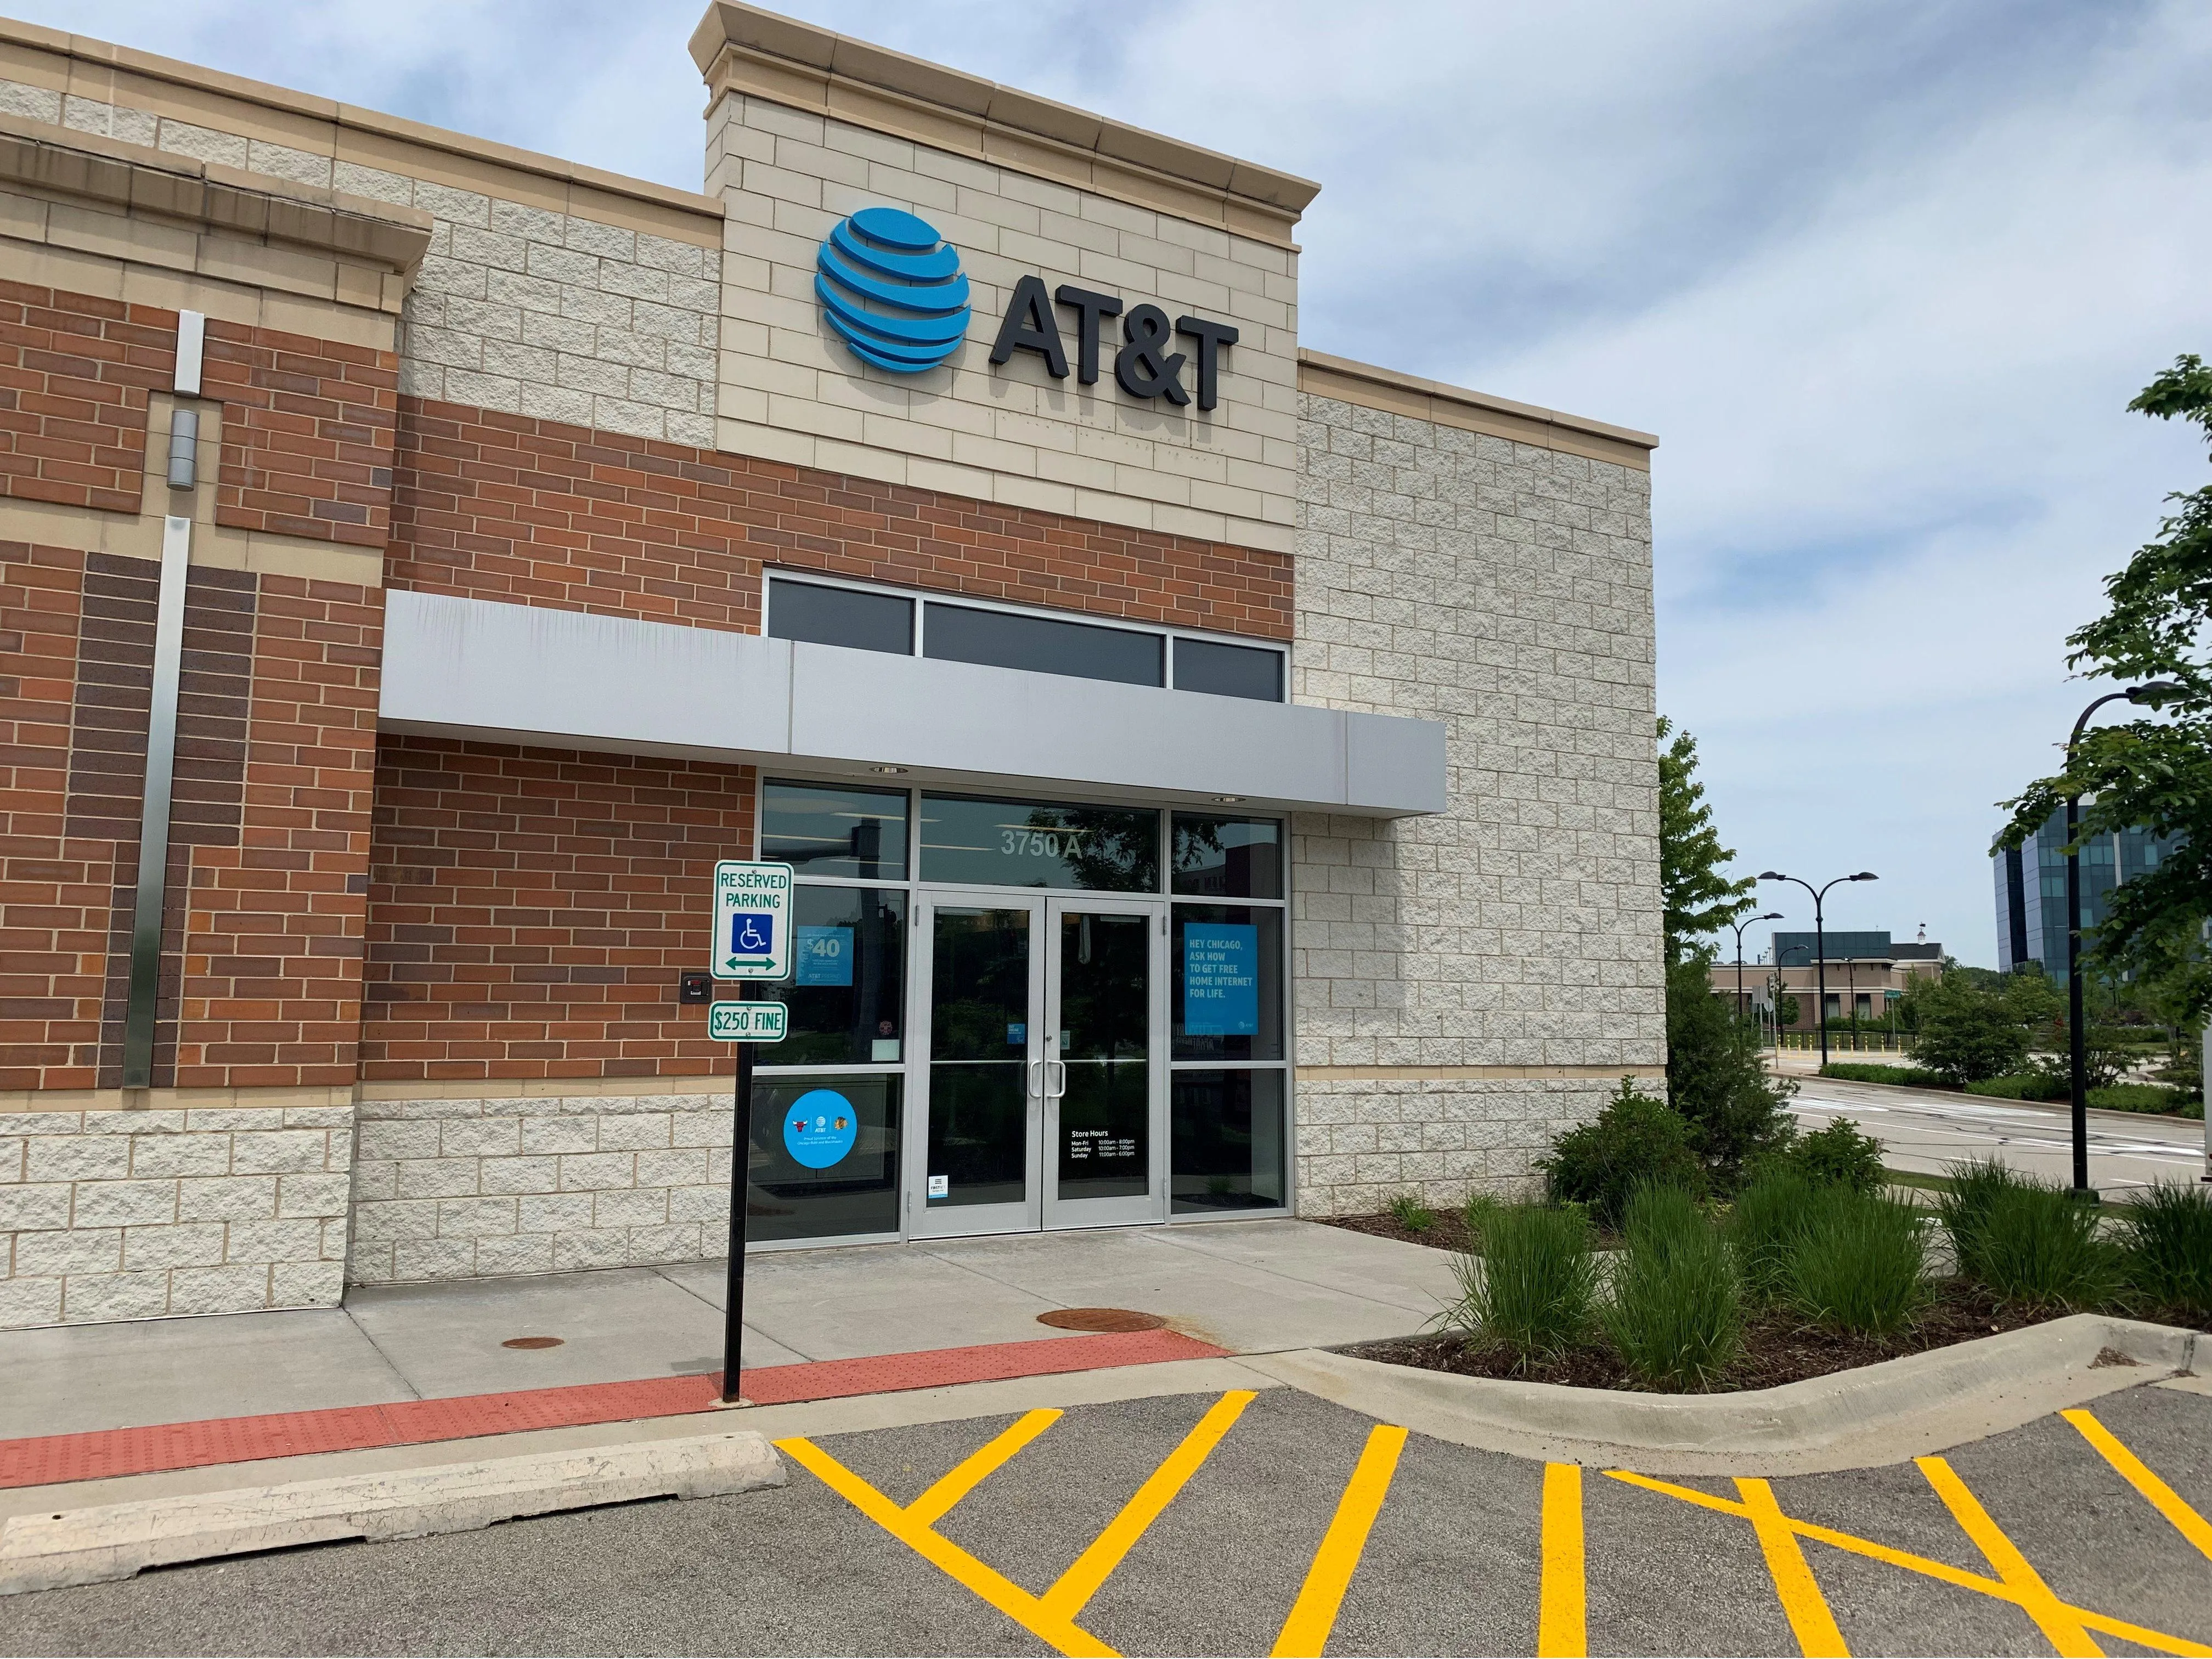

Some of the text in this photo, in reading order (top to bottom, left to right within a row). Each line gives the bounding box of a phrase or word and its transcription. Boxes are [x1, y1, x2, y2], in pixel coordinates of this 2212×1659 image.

[988, 274, 1239, 411] AT&T
[1001, 830, 1083, 859] 3750 A
[720, 873, 786, 889] RESERVED
[726, 893, 780, 909] PARKING
[807, 939, 840, 957] $40
[1189, 939, 1243, 950] HEY CHICAGO,
[1189, 952, 1225, 961] ASK HOW
[1189, 964, 1238, 973] TO GET FREE
[1189, 977, 1252, 986] HOME INTERNET
[1189, 989, 1226, 998] FOR LIFE.
[714, 1011, 781, 1031] $250 FINE
